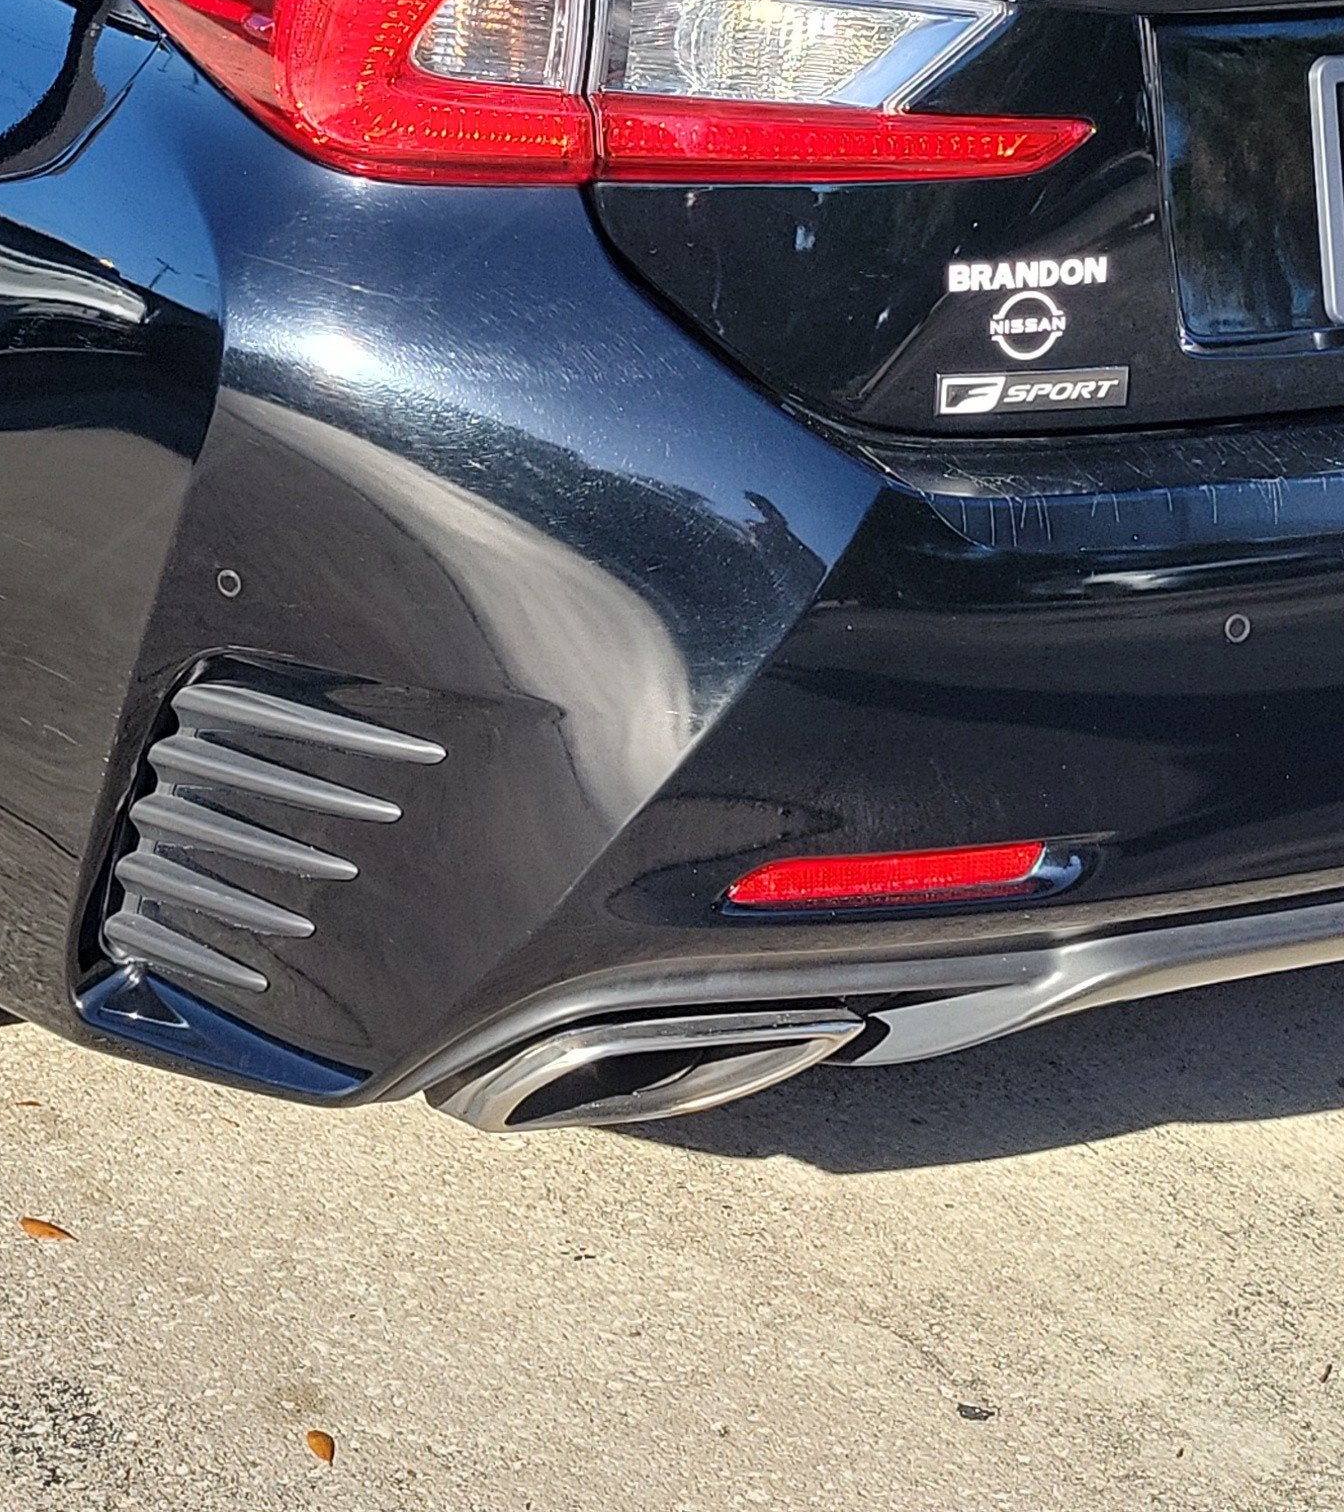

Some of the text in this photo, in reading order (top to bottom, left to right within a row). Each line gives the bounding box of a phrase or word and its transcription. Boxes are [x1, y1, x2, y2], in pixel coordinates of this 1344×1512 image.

[948, 256, 1108, 292] BRANDON
[989, 316, 1067, 335] NISSAN
[1003, 379, 1119, 402] SPORT
